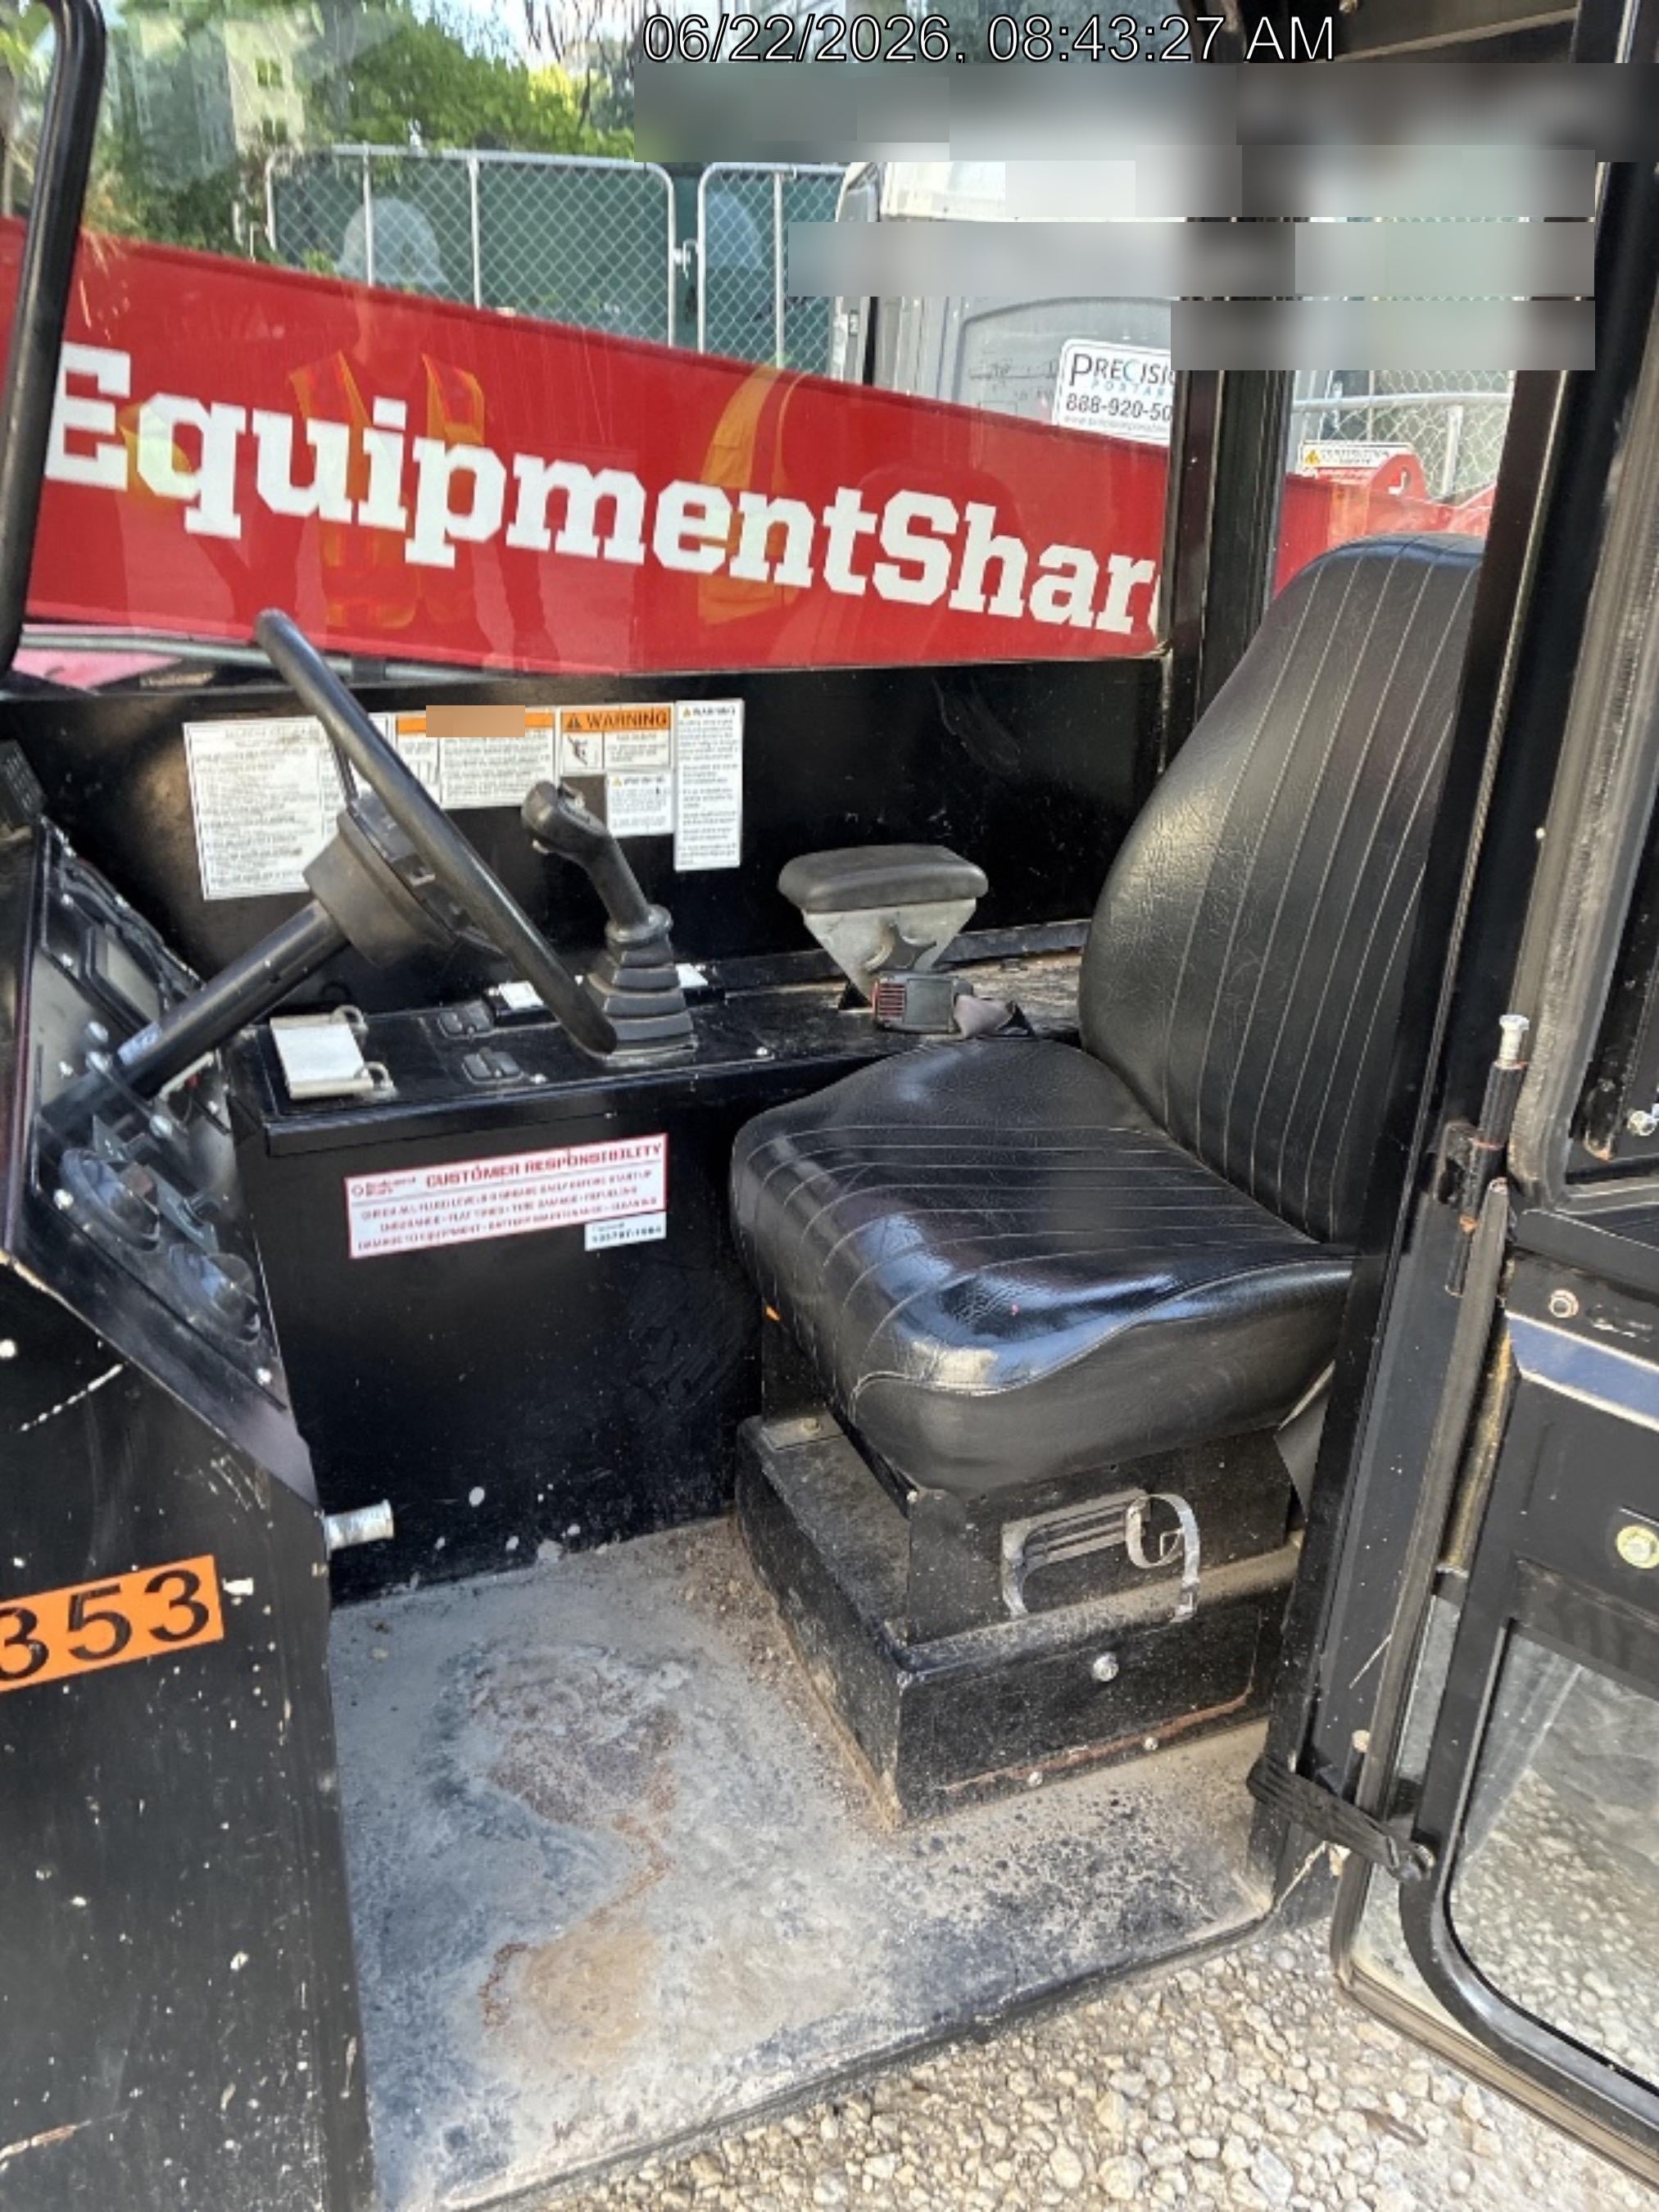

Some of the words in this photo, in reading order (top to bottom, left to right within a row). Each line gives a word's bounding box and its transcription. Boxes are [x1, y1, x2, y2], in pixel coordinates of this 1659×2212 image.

[45, 341, 1161, 637] EquipmentShar
[587, 707, 667, 729] WARNING
[427, 1162, 519, 1188] CUSTOMER
[525, 1144, 662, 1174] RESPONSIBILITY
[0, 1568, 211, 1680] 353
